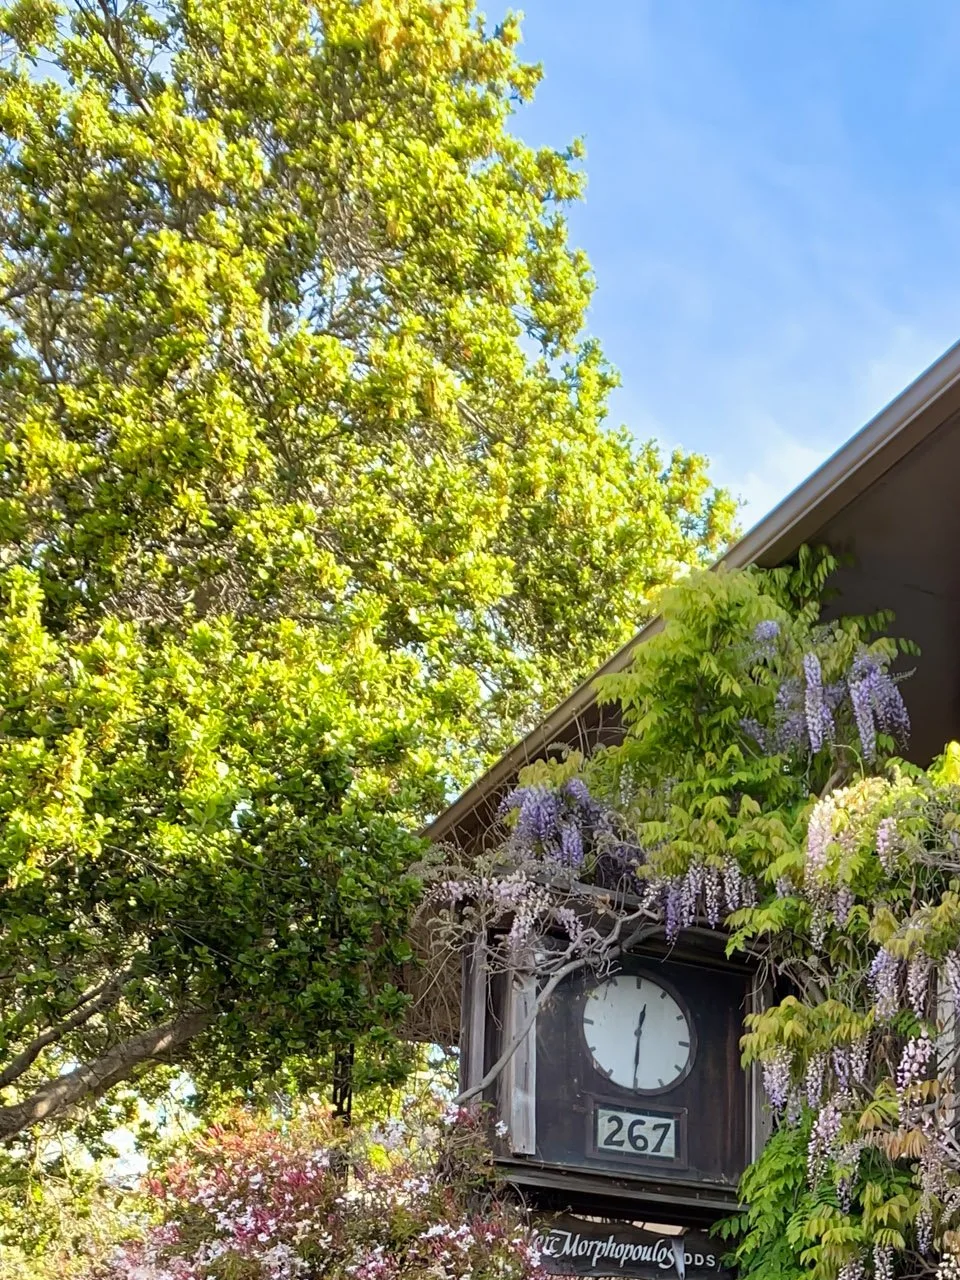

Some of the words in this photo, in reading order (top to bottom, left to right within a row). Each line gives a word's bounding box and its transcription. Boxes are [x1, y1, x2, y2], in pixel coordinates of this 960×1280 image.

[603, 1115, 672, 1153] 267
[552, 1229, 675, 1269] Morphopoulos
[684, 1252, 716, 1267] DDS
